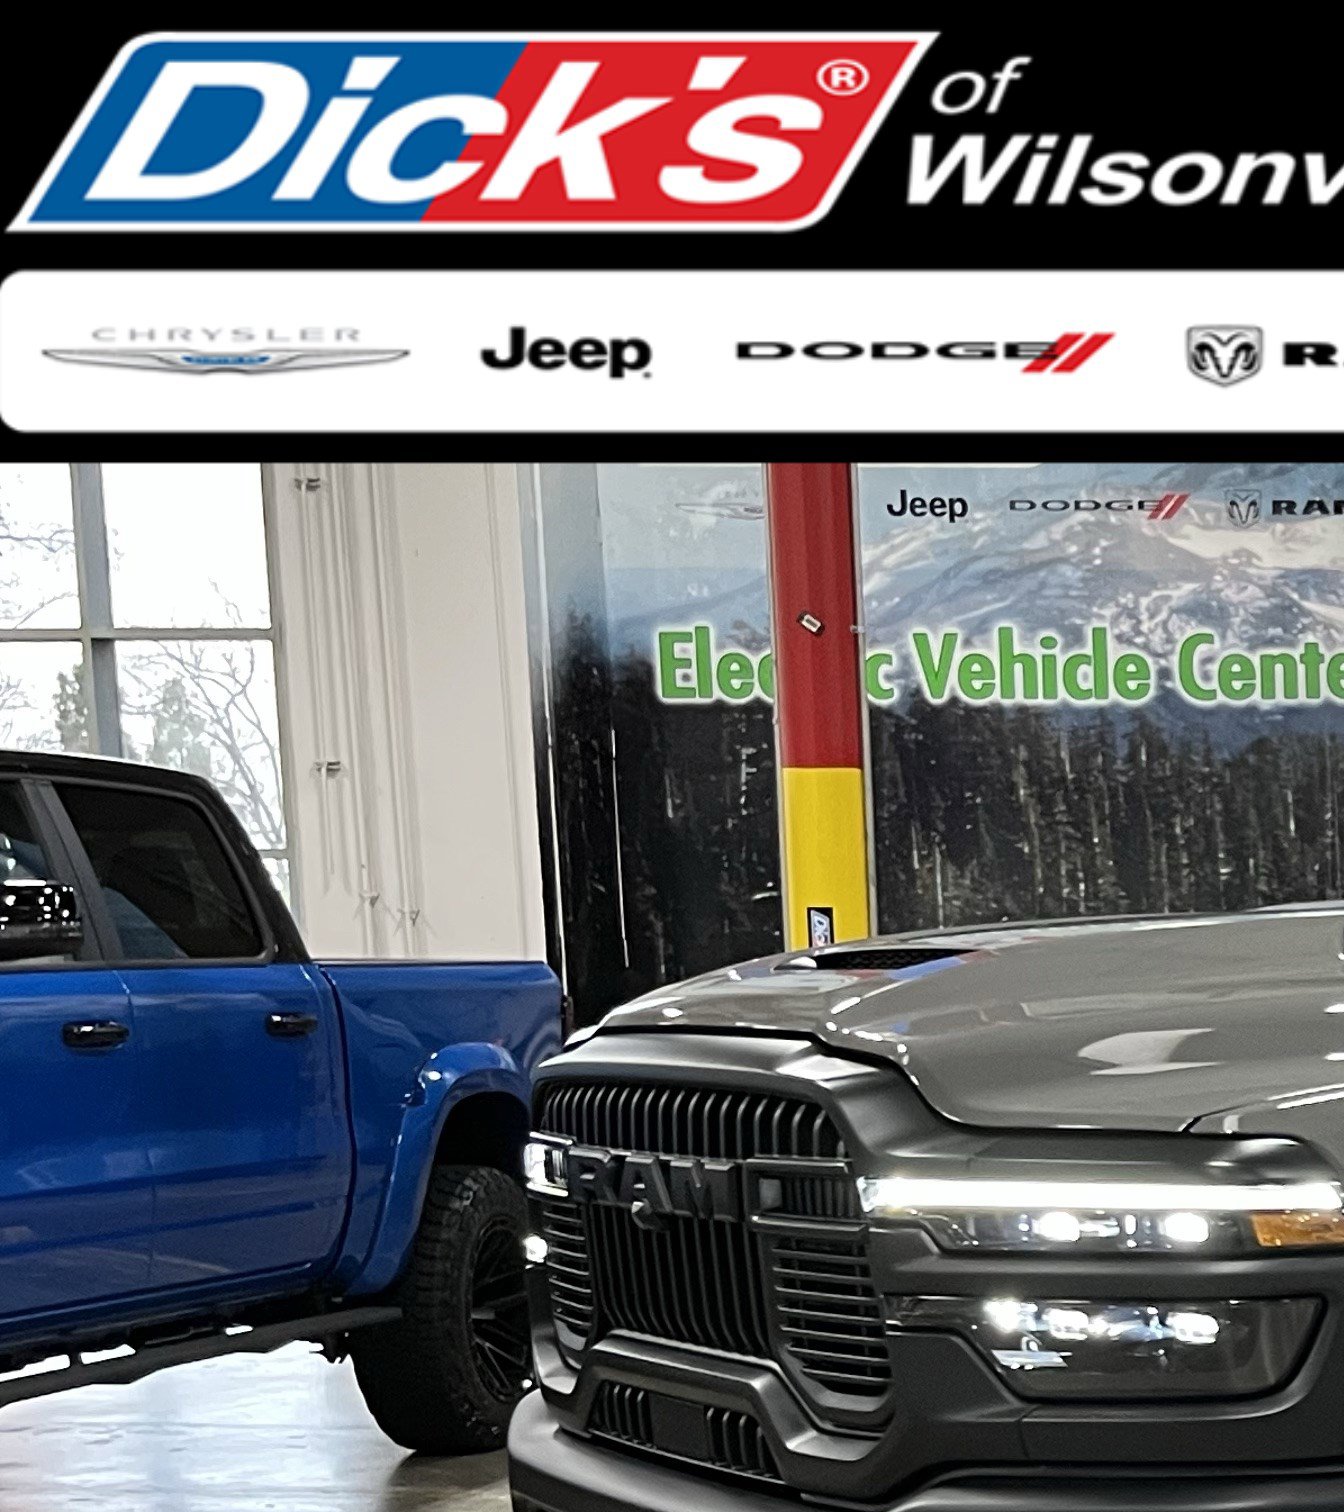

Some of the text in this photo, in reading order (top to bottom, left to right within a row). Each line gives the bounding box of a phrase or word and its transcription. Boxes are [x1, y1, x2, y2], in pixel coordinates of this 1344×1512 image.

[886, 488, 969, 523] Jeep
[1008, 498, 1164, 513] DODGE
[912, 625, 1152, 702] Vehicle
[567, 1146, 738, 1224] RAM
